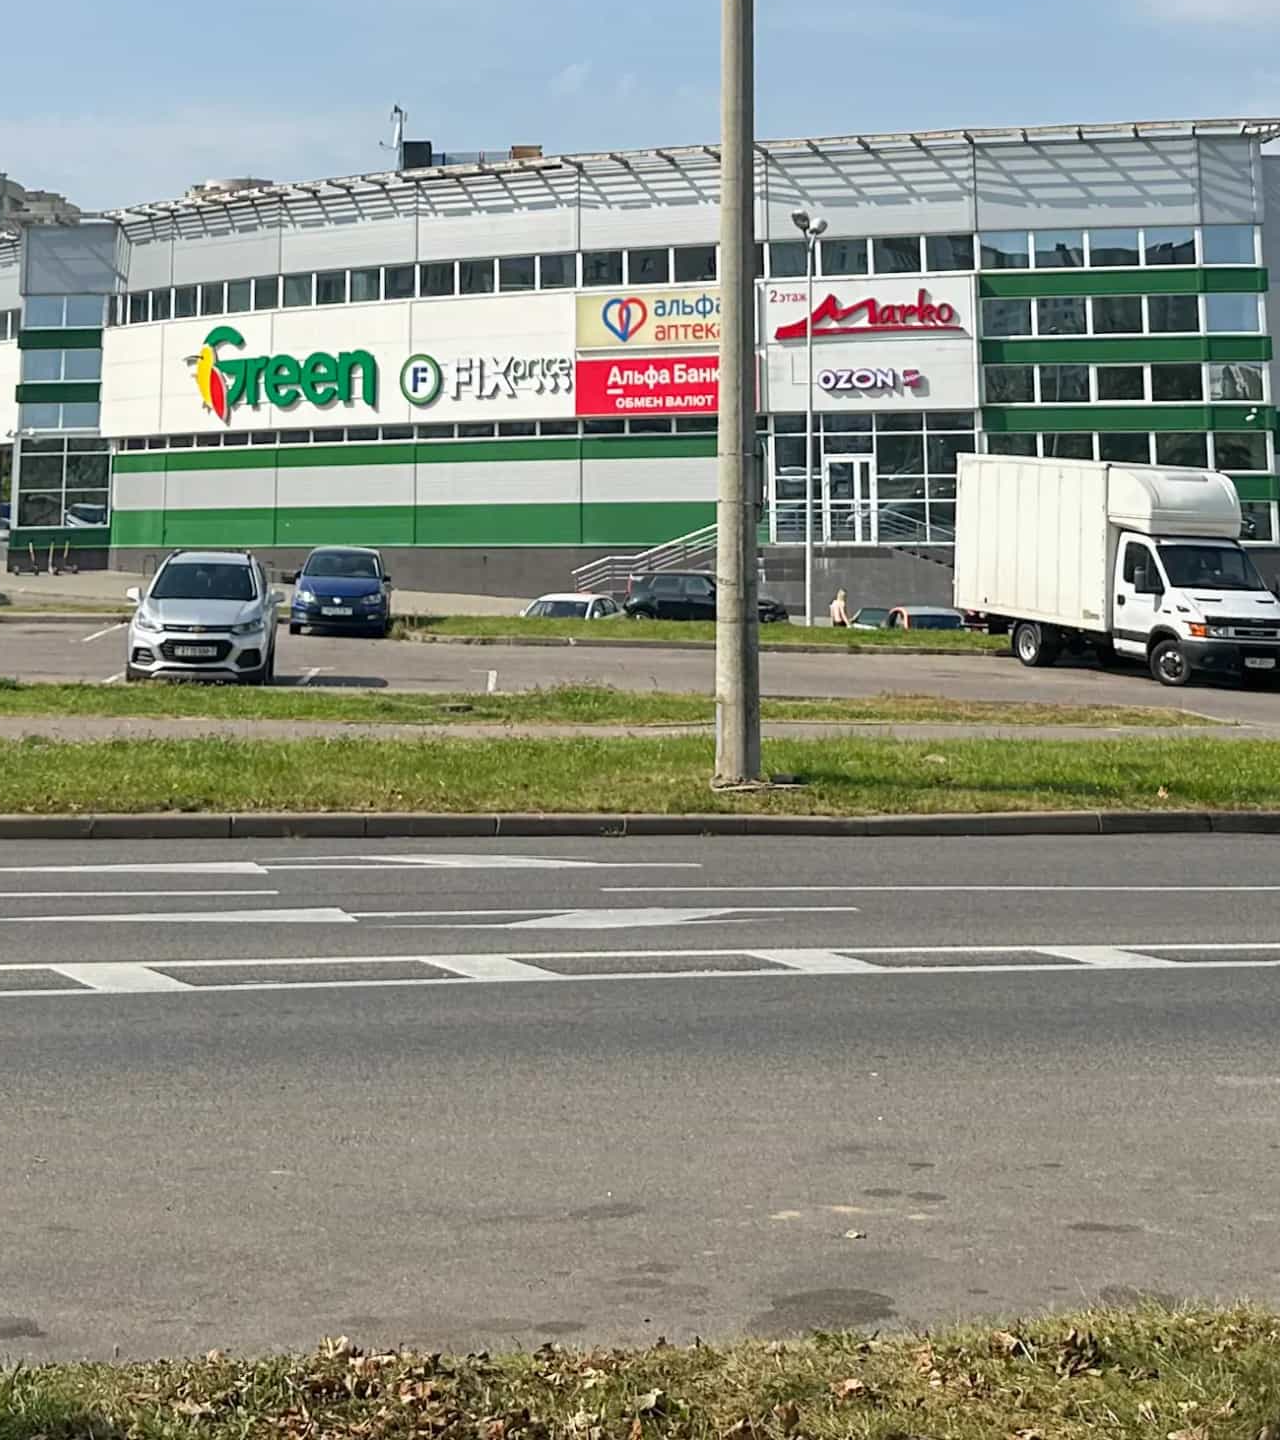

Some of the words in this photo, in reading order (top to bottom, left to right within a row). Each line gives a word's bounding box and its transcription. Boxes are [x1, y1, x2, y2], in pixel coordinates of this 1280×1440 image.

[770, 290, 777, 303] 2
[779, 293, 807, 303] этаж
[775, 288, 963, 340] Marko
[200, 325, 379, 410] Green
[607, 364, 671, 390] Альфа
[818, 368, 894, 390] OZON
[615, 396, 663, 409] ОБМЕН
[664, 394, 714, 408] ВАЛЮТ
